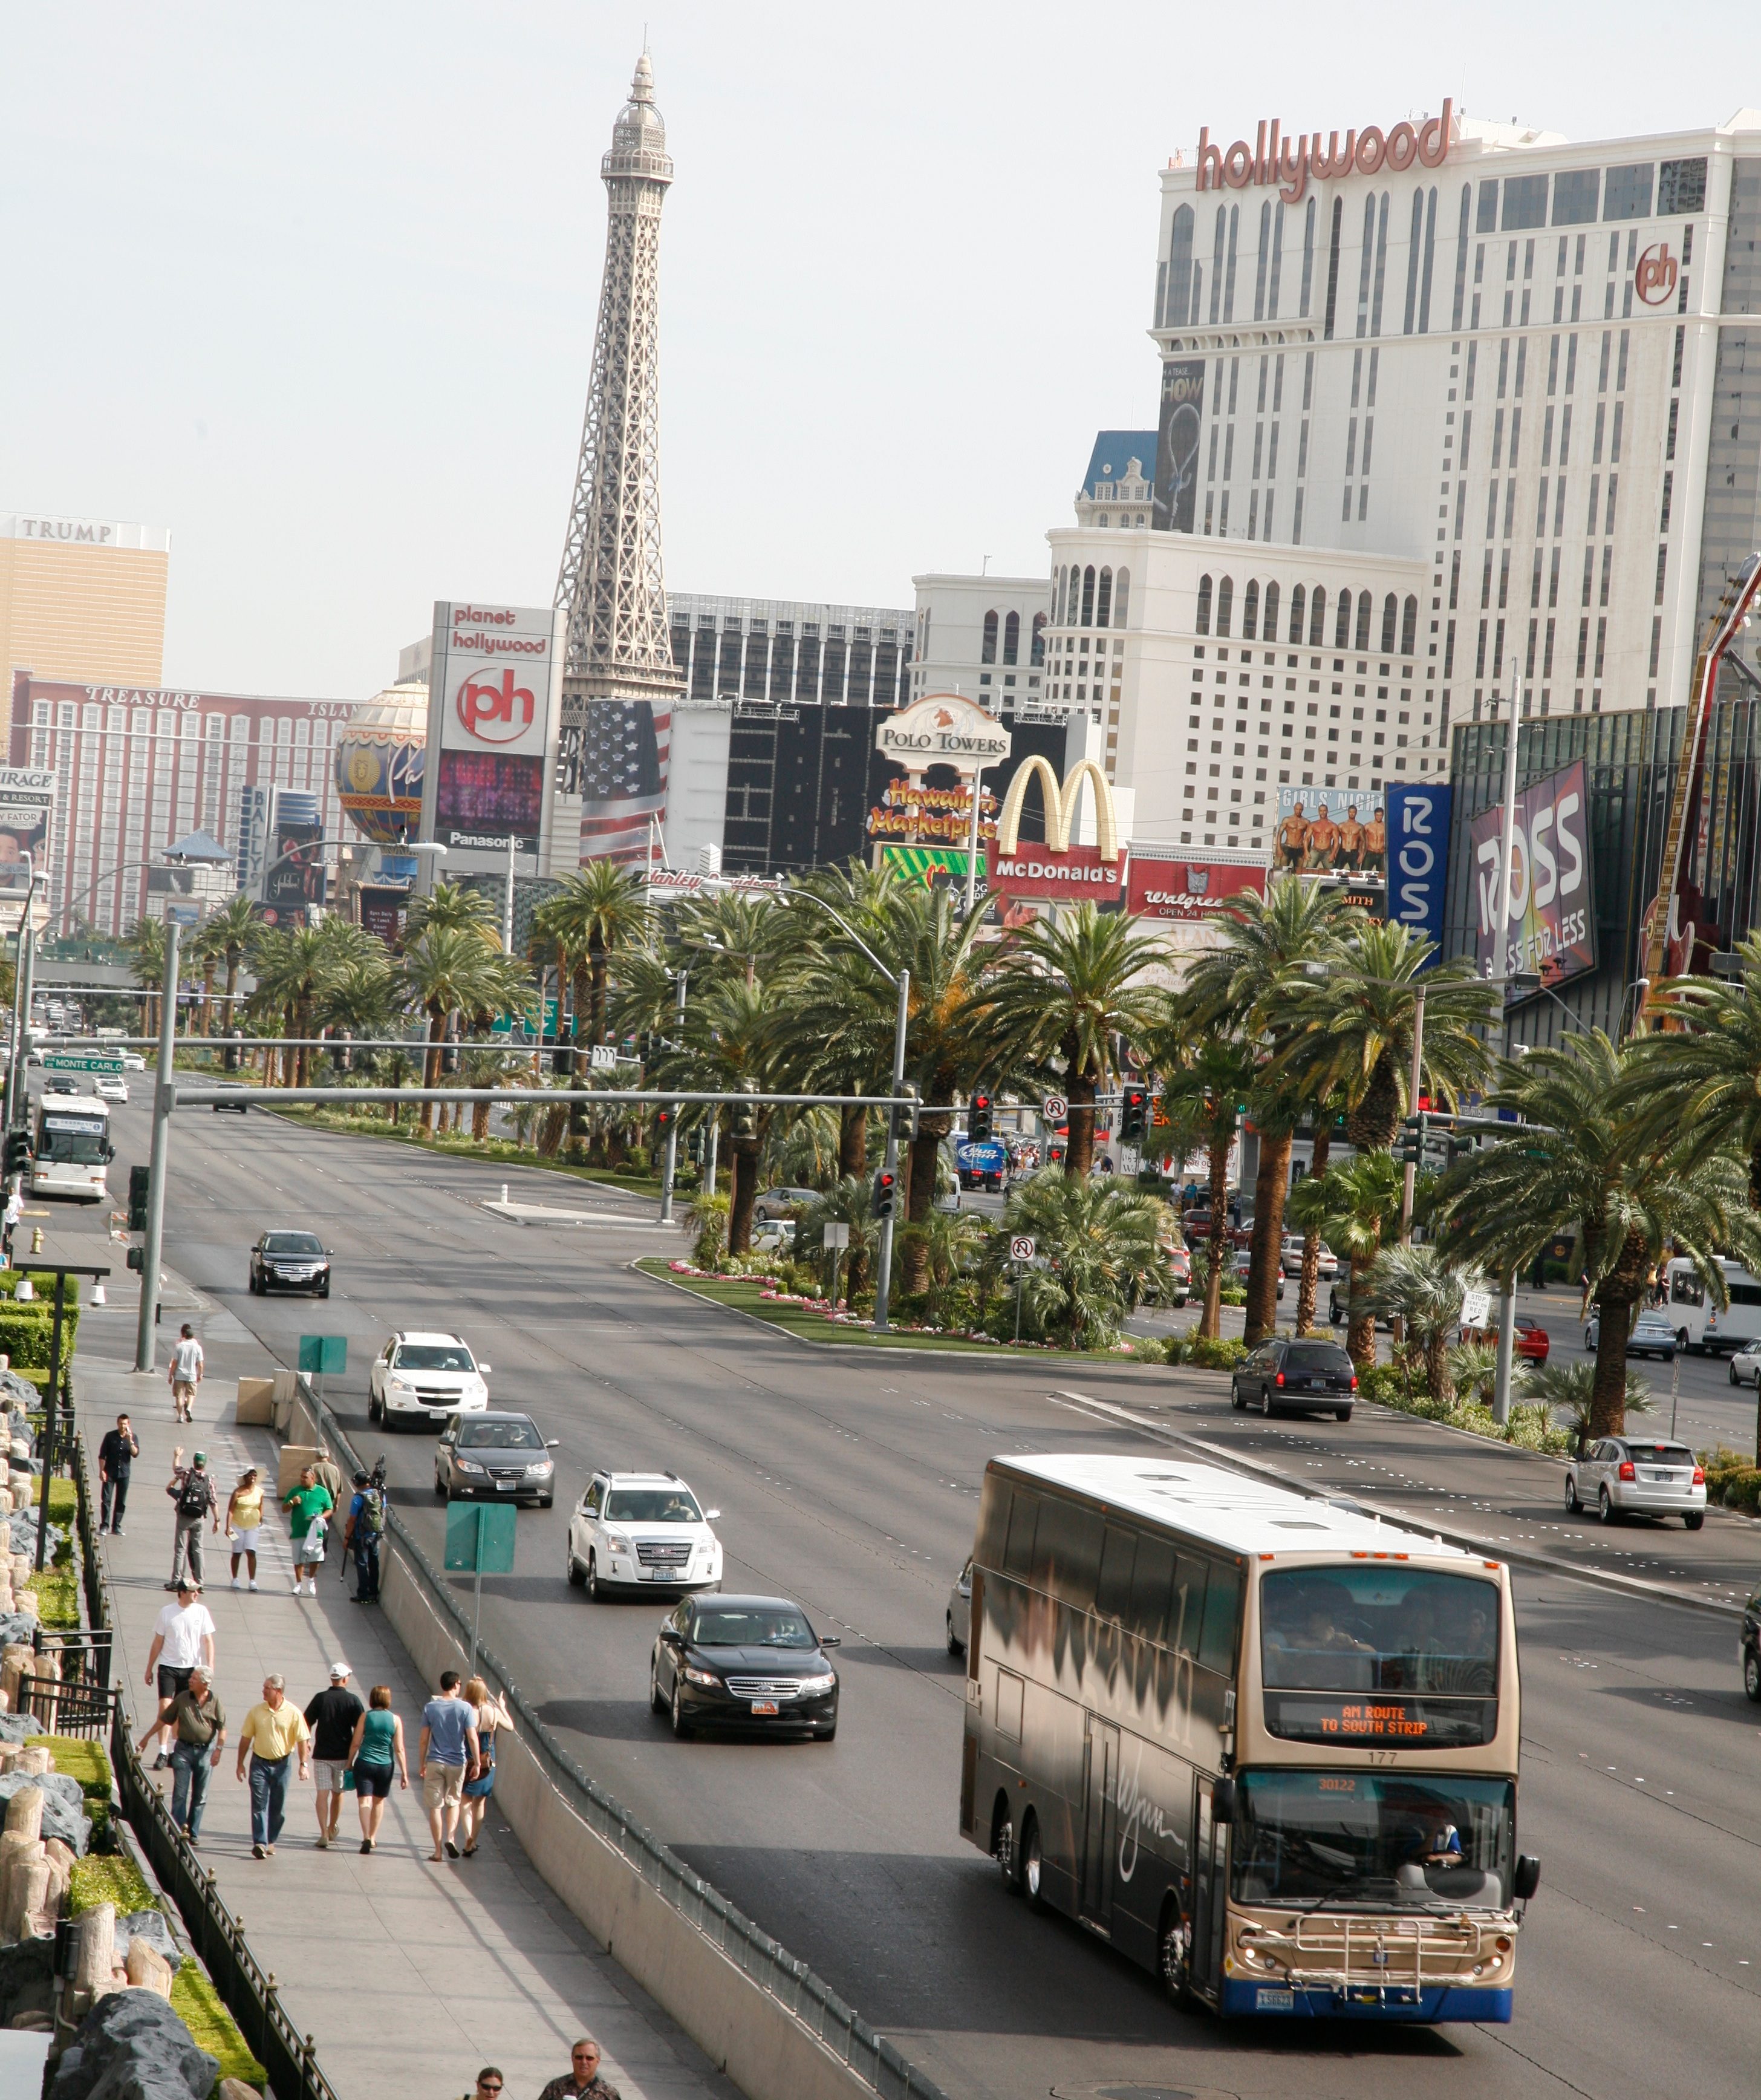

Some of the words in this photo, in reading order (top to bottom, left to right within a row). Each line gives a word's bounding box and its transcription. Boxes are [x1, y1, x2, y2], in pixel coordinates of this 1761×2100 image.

[1195, 97, 1454, 204] hollywood
[1639, 244, 1678, 295] ph
[1162, 377, 1203, 402] HOW
[23, 519, 112, 543] TRUMP
[454, 605, 516, 627] planet
[453, 631, 546, 654] hollywood
[86, 686, 200, 709] TREASURE
[464, 668, 535, 734] ph
[308, 702, 361, 719] ISLAN
[883, 728, 931, 749] POLO
[937, 732, 1006, 754] TOWERS
[0, 772, 52, 788] IRAGE
[11, 794, 48, 804] RESORT
[889, 778, 998, 813] Hawaiian
[1283, 788, 1332, 809] GIRLS'
[7, 813, 37, 821] FATOR
[868, 806, 998, 843] Marketplce
[450, 831, 524, 850] Panasonc
[996, 861, 1117, 883] McDonald's
[1399, 796, 1434, 939] ROS
[1144, 890, 1226, 908] Walgree
[1342, 895, 1374, 906] MITH
[1159, 908, 1184, 917] OPEN
[1528, 927, 1552, 966] FOR
[1555, 908, 1586, 952] LESS
[56, 1060, 88, 1069] MONTE
[90, 1061, 122, 1072] CARLO
[1471, 1294, 1486, 1302] STOP
[1343, 1706, 1361, 1718] AM
[1365, 1706, 1406, 1720] ROUTE
[1321, 1718, 1338, 1732] TO
[1341, 1719, 1384, 1733] SOUTH
[1388, 1721, 1428, 1736] STRIP
[1369, 1751, 1398, 1764] 177
